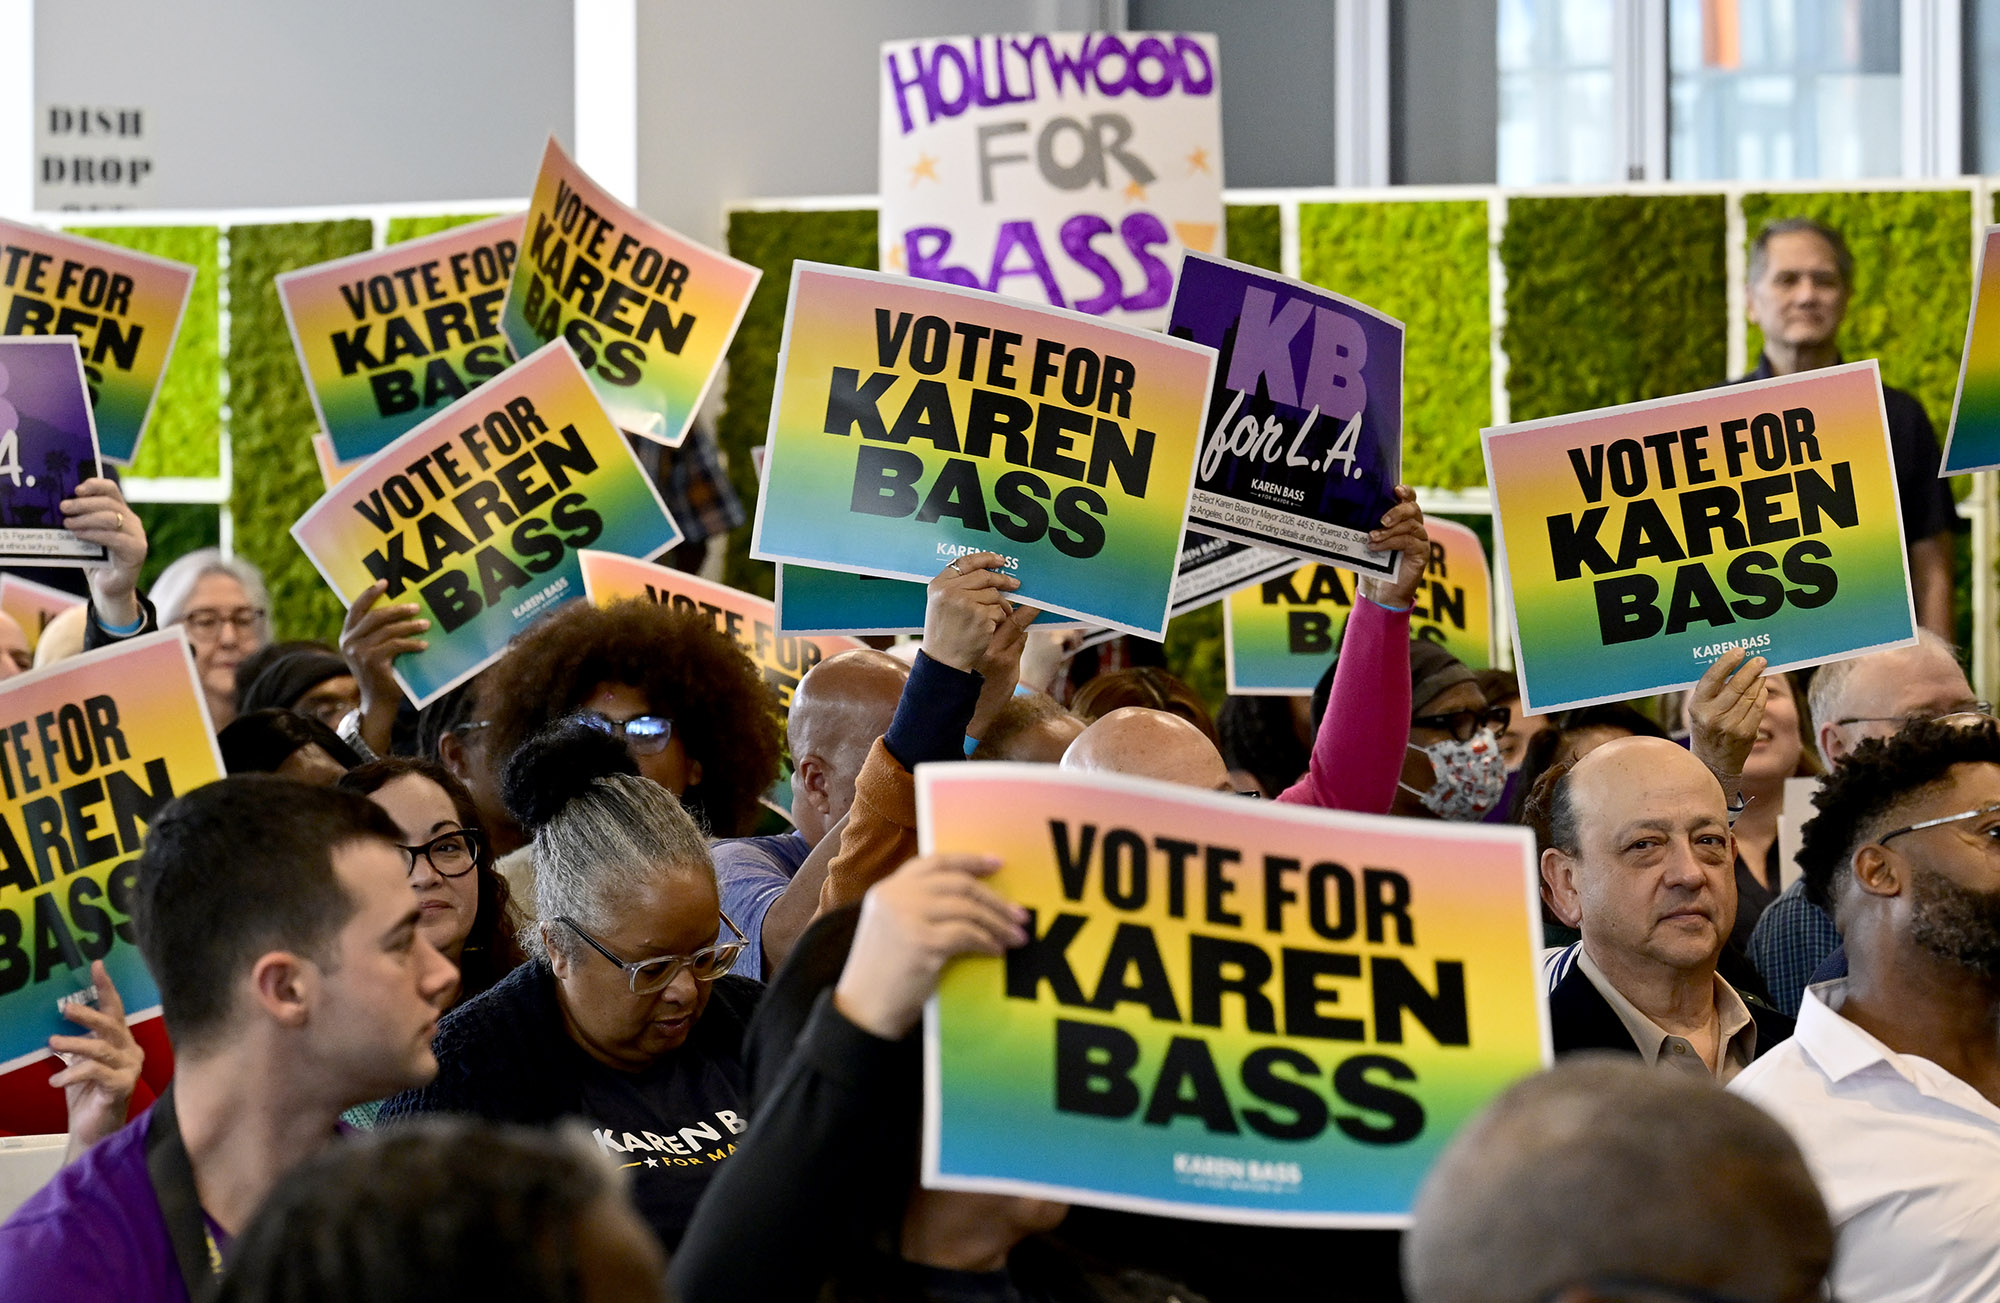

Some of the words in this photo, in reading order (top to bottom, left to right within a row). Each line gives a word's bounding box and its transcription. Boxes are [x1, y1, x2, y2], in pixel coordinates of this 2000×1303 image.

[47, 107, 142, 136] DISH
[888, 35, 1214, 133] HOLLYWOOD
[42, 155, 152, 187] DROP
[975, 112, 1156, 204] FOR
[0, 245, 52, 294] TE
[56, 260, 134, 317] FOR
[530, 212, 697, 356] KAREN
[554, 180, 614, 262] VOTE
[609, 234, 689, 301] FOR
[903, 213, 1173, 317] BASS
[3, 295, 144, 372] REN
[330, 288, 505, 376] KARE
[339, 261, 447, 322] VOTE
[524, 272, 647, 387] BASS
[369, 345, 515, 417] BAS
[875, 307, 1023, 387] VOTE
[1030, 338, 1136, 421] FOR
[1225, 285, 1368, 421] KB
[353, 442, 472, 534] VOTE
[459, 396, 548, 471] FOR
[823, 367, 1155, 499] KAREN
[1200, 389, 1283, 482] for
[1286, 404, 1363, 479] L.A.
[1567, 425, 1715, 502] VOTE
[1721, 406, 1822, 478] FOR
[362, 423, 598, 600] KAREN
[850, 446, 1109, 560] BASS
[1192, 493, 1214, 503] e-Elect
[1215, 498, 1234, 509] Karen
[1234, 502, 1250, 514] Bass
[1251, 506, 1259, 516] for
[1261, 509, 1279, 522] Mayor
[1224, 512, 1235, 522] CA
[1256, 521, 1279, 536] Funding
[1251, 478, 1282, 497] KAREN
[1282, 486, 1306, 502] BASS
[1546, 460, 1860, 581] KAREN
[419, 492, 603, 634] BASS
[936, 542, 986, 557] KARE
[1261, 564, 1465, 630] KAN
[1593, 539, 1839, 646] BASS
[1741, 633, 1771, 650] BASS
[0, 719, 42, 800] TE
[36, 693, 130, 784] FOR
[0, 757, 174, 897] AREN
[1048, 819, 1243, 929] VOTE
[1263, 854, 1414, 947] FOR
[1005, 906, 1471, 1047] KAREN
[1055, 1016, 1427, 1147] BASS
[591, 1121, 722, 1158] KAREN
[662, 1156, 704, 1169] FOR
